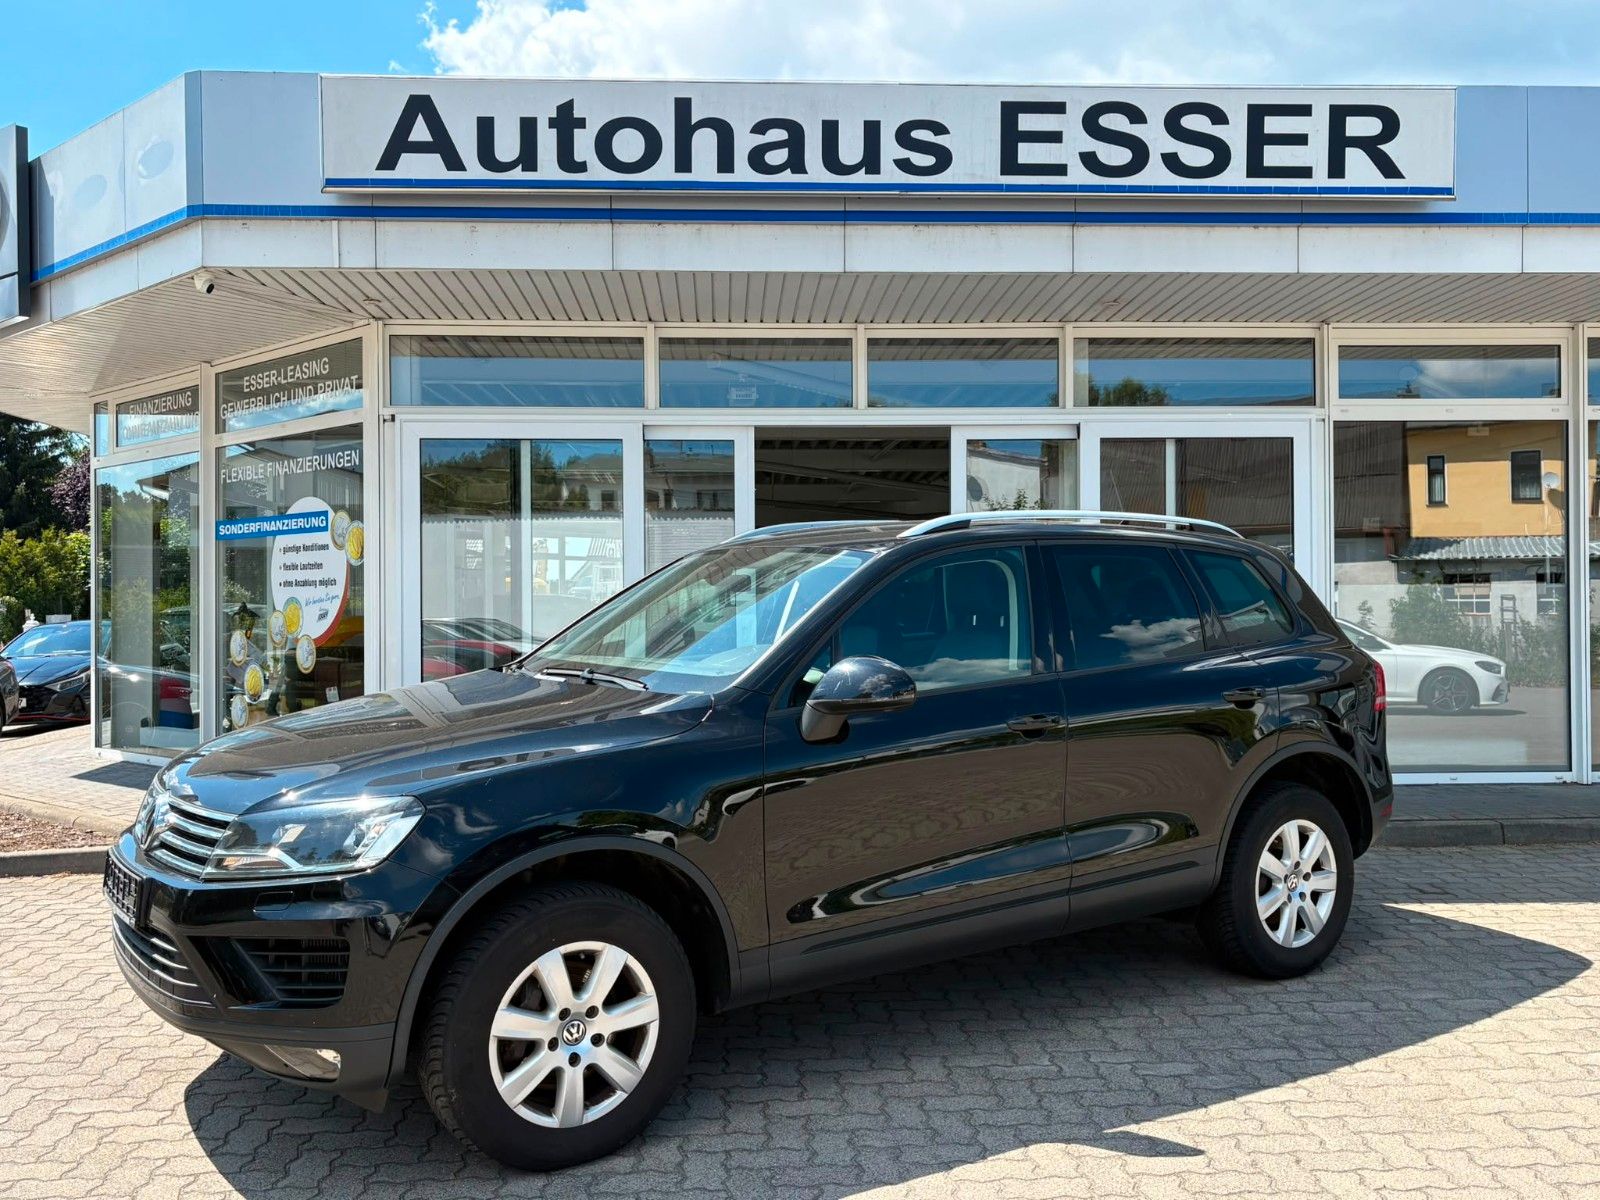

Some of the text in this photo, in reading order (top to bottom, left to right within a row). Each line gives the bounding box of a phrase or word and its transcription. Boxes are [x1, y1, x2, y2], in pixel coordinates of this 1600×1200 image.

[375, 94, 1406, 179] Autohaus ESSER
[243, 357, 329, 392] ESSER-LEASING
[129, 391, 192, 418] FINANZIERUNG
[220, 375, 359, 419] GEWERBLICH UND PRIVAT
[220, 449, 360, 484] FLEXIBLE FINANZIERUNGEN
[218, 516, 326, 536] SONDERFINANZIERUNG
